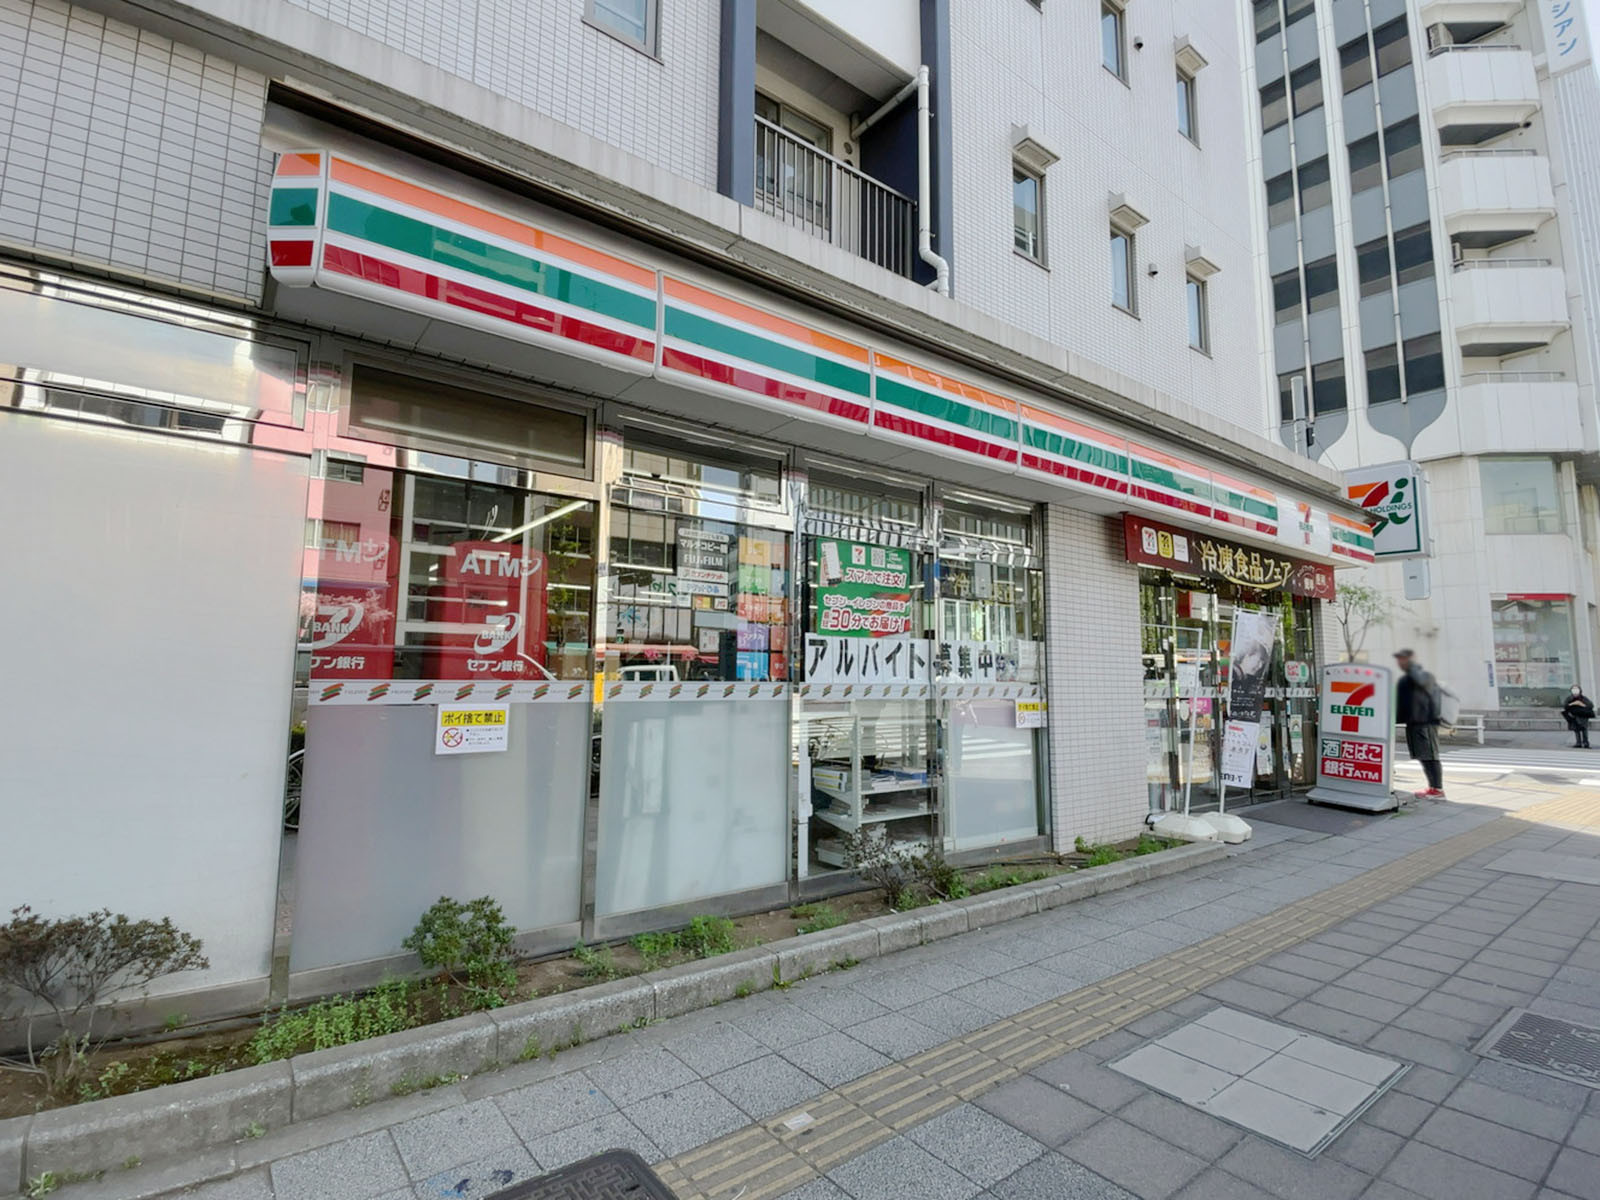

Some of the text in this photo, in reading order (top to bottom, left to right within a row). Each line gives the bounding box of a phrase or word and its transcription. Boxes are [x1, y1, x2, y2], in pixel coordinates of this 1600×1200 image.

[1200, 540, 1293, 587] 冷凍食品フェア
[467, 658, 524, 672] セブン銀行
[444, 712, 503, 724] ポイ捨て禁止
[1323, 741, 1382, 762] 酒 たばこ
